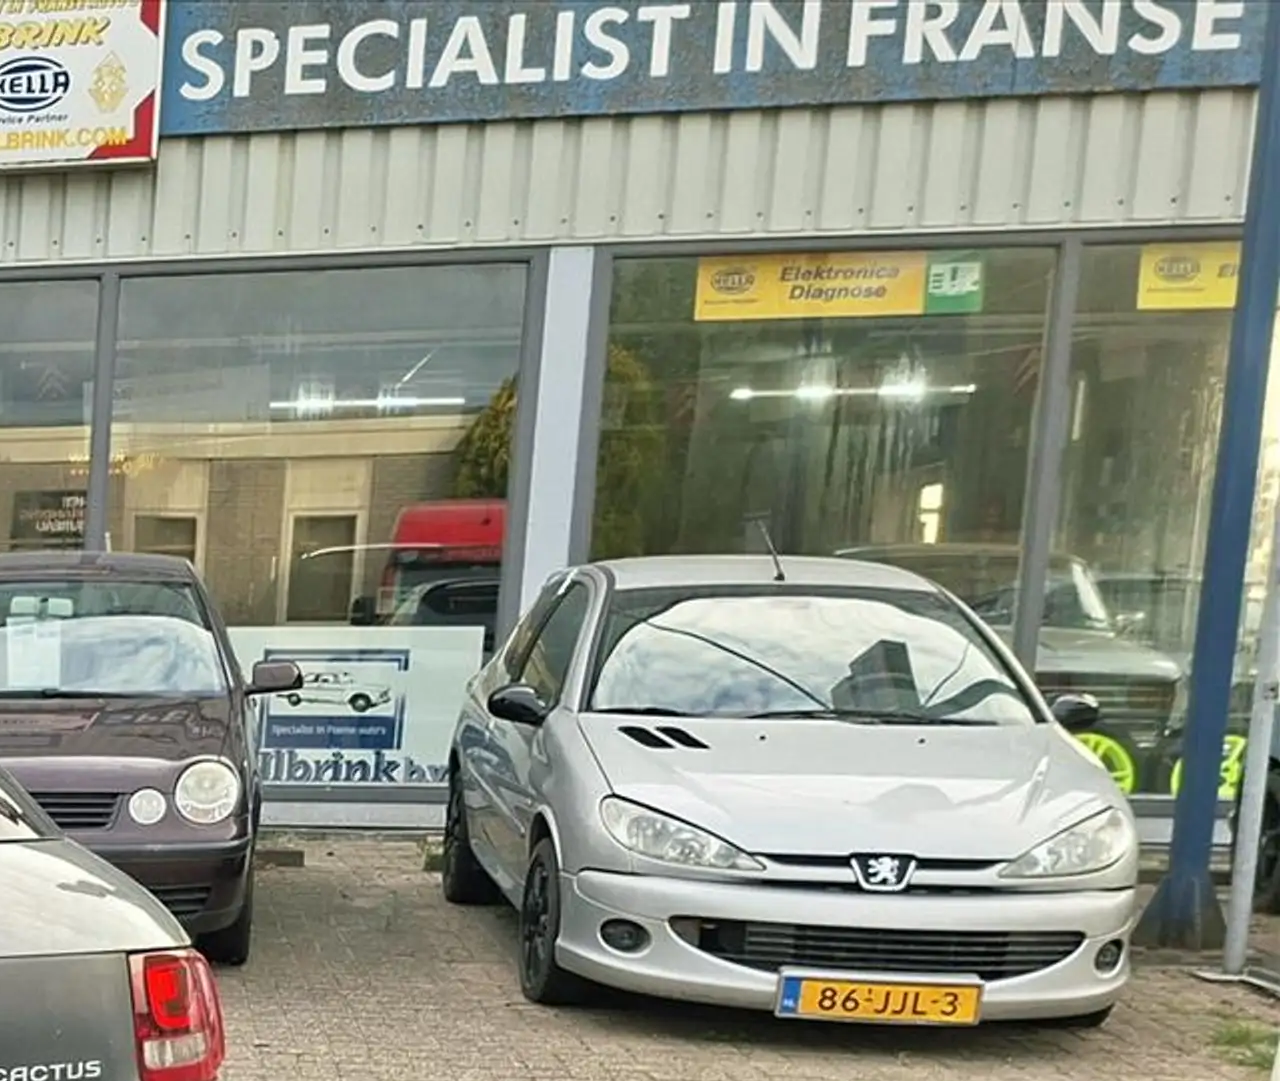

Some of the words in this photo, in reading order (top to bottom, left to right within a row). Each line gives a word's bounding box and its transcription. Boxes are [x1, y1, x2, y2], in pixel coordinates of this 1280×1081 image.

[180, 4, 689, 101] SPECIALIST
[712, 0, 822, 74] IN
[846, 0, 1242, 68] FRANSE
[26, 113, 69, 125] Partner
[779, 264, 900, 283] Elektronica
[788, 283, 888, 302] Diagnose
[818, 986, 959, 1017] 86-JJL-3
